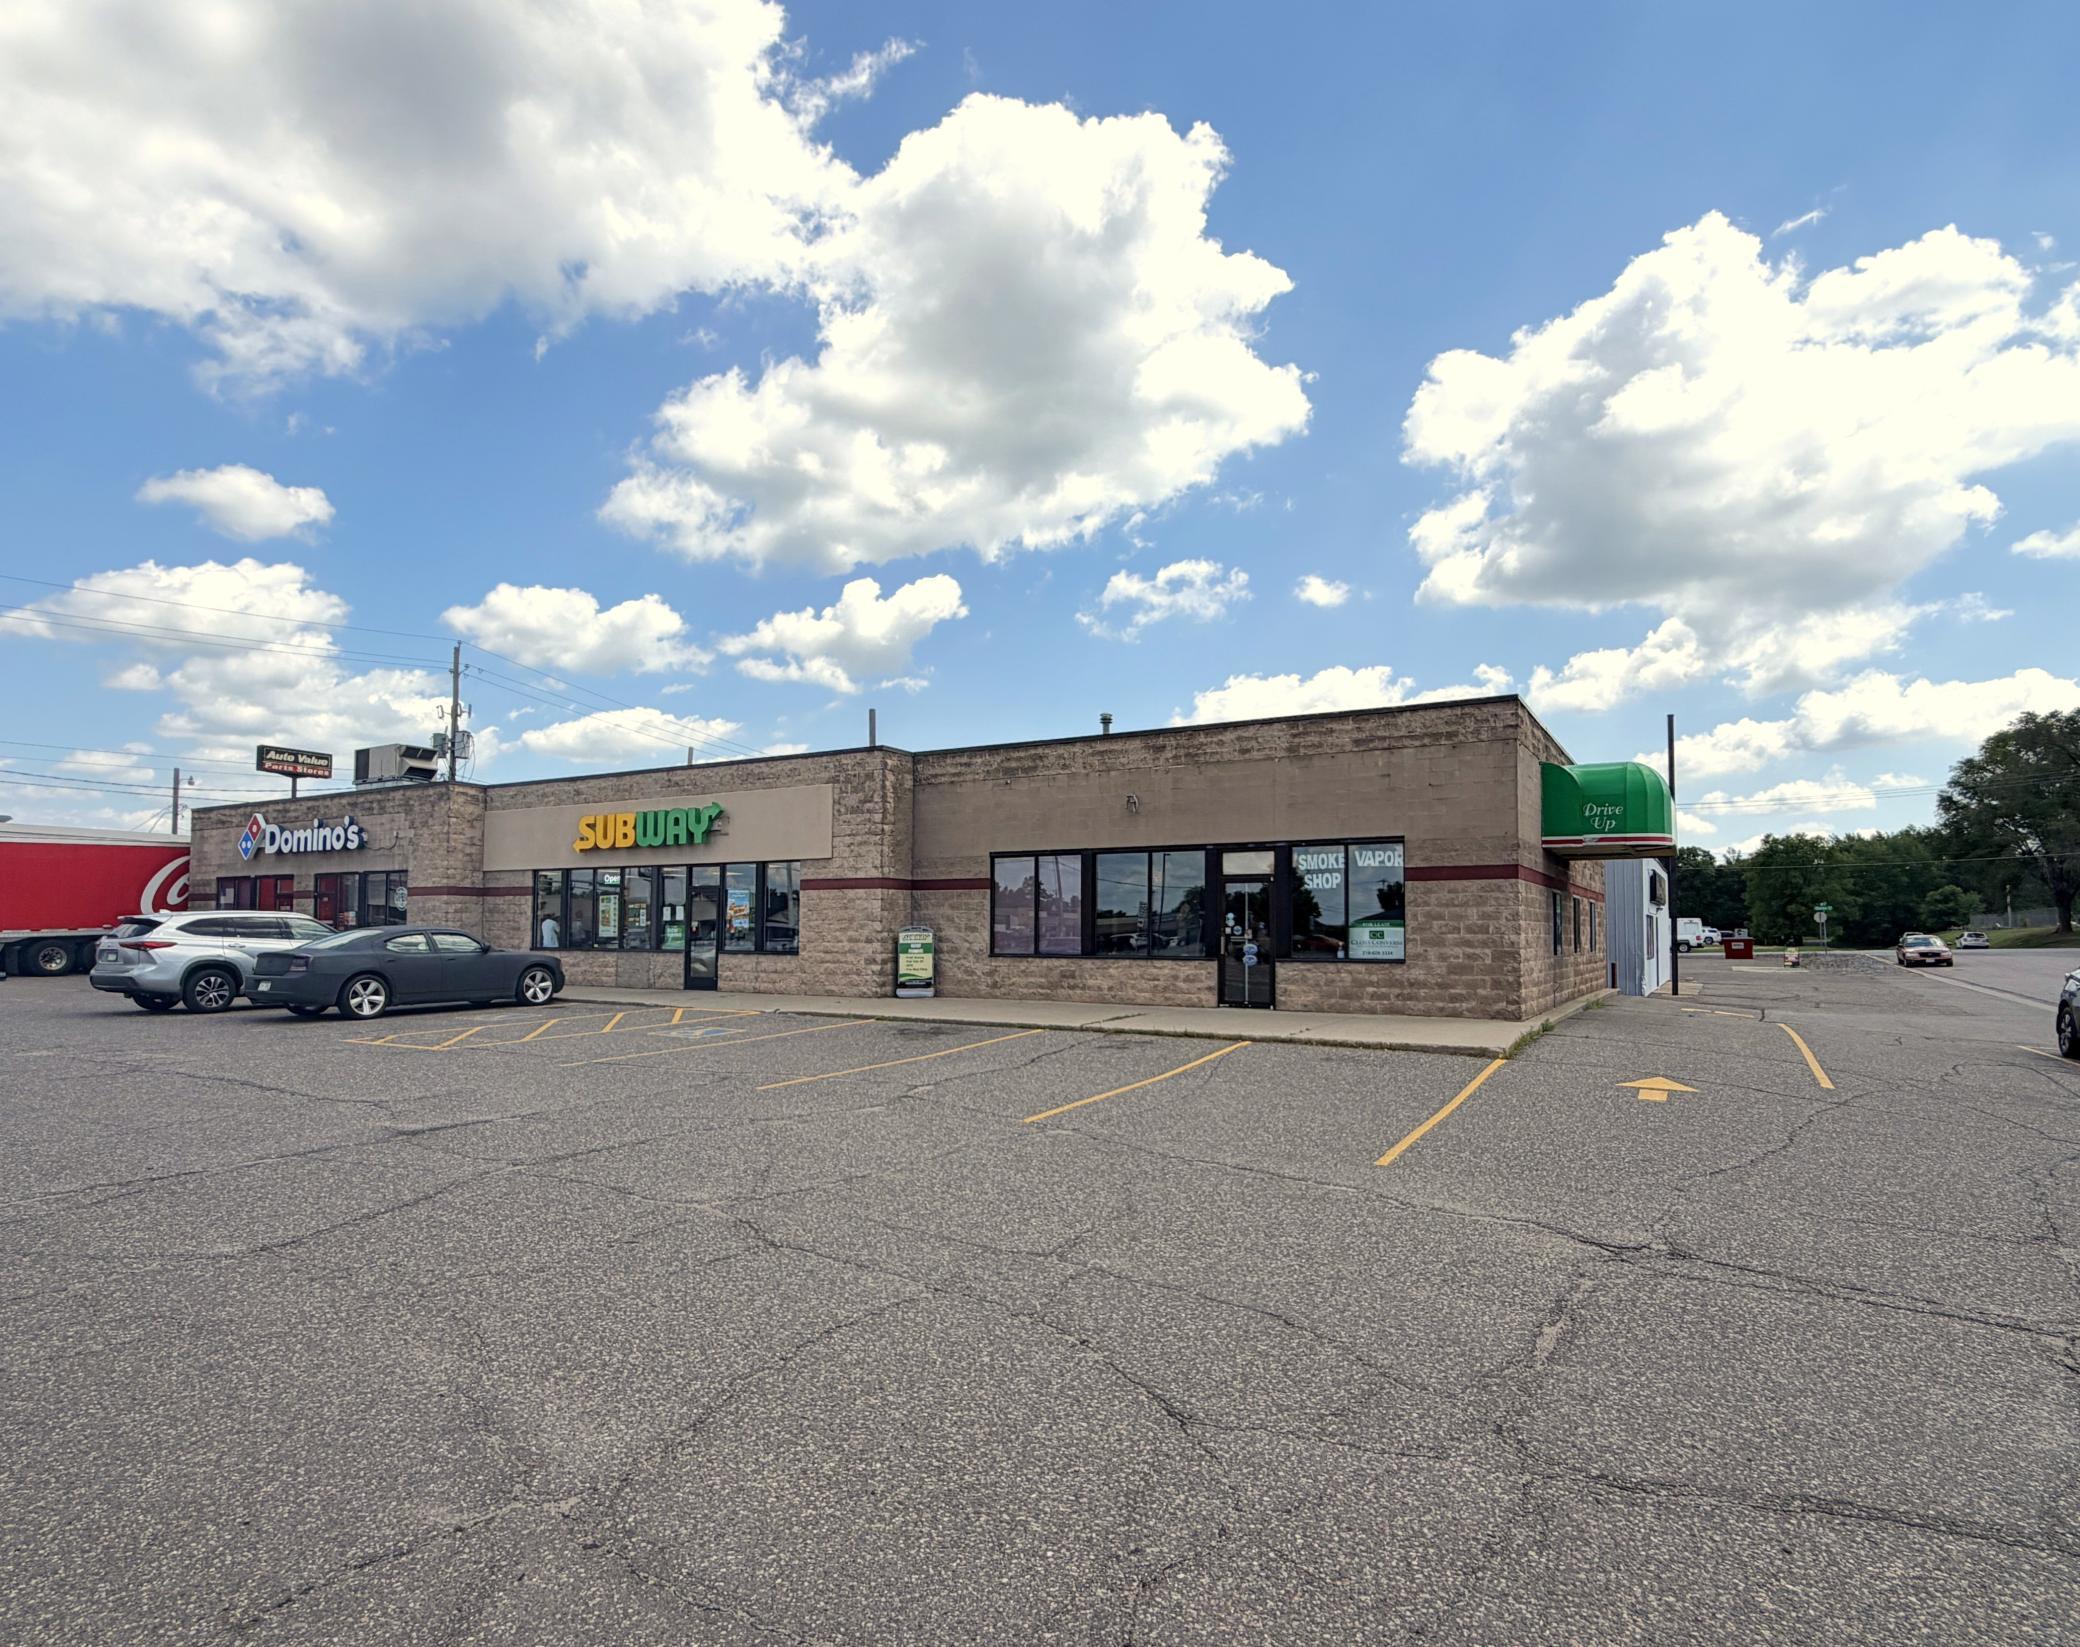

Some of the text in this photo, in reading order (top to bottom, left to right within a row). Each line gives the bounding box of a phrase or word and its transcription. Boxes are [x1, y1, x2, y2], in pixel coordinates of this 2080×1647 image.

[266, 750, 329, 766] Auto Value
[264, 762, 330, 776] Parts Stores
[1583, 802, 1623, 816] Drive
[573, 802, 722, 853] SUBWAY
[1590, 817, 1616, 832] Up
[265, 816, 359, 854] Domino's
[1299, 853, 1345, 870] SMOKE
[1354, 851, 1404, 867] VAPOR
[1304, 873, 1341, 889] SHOP
